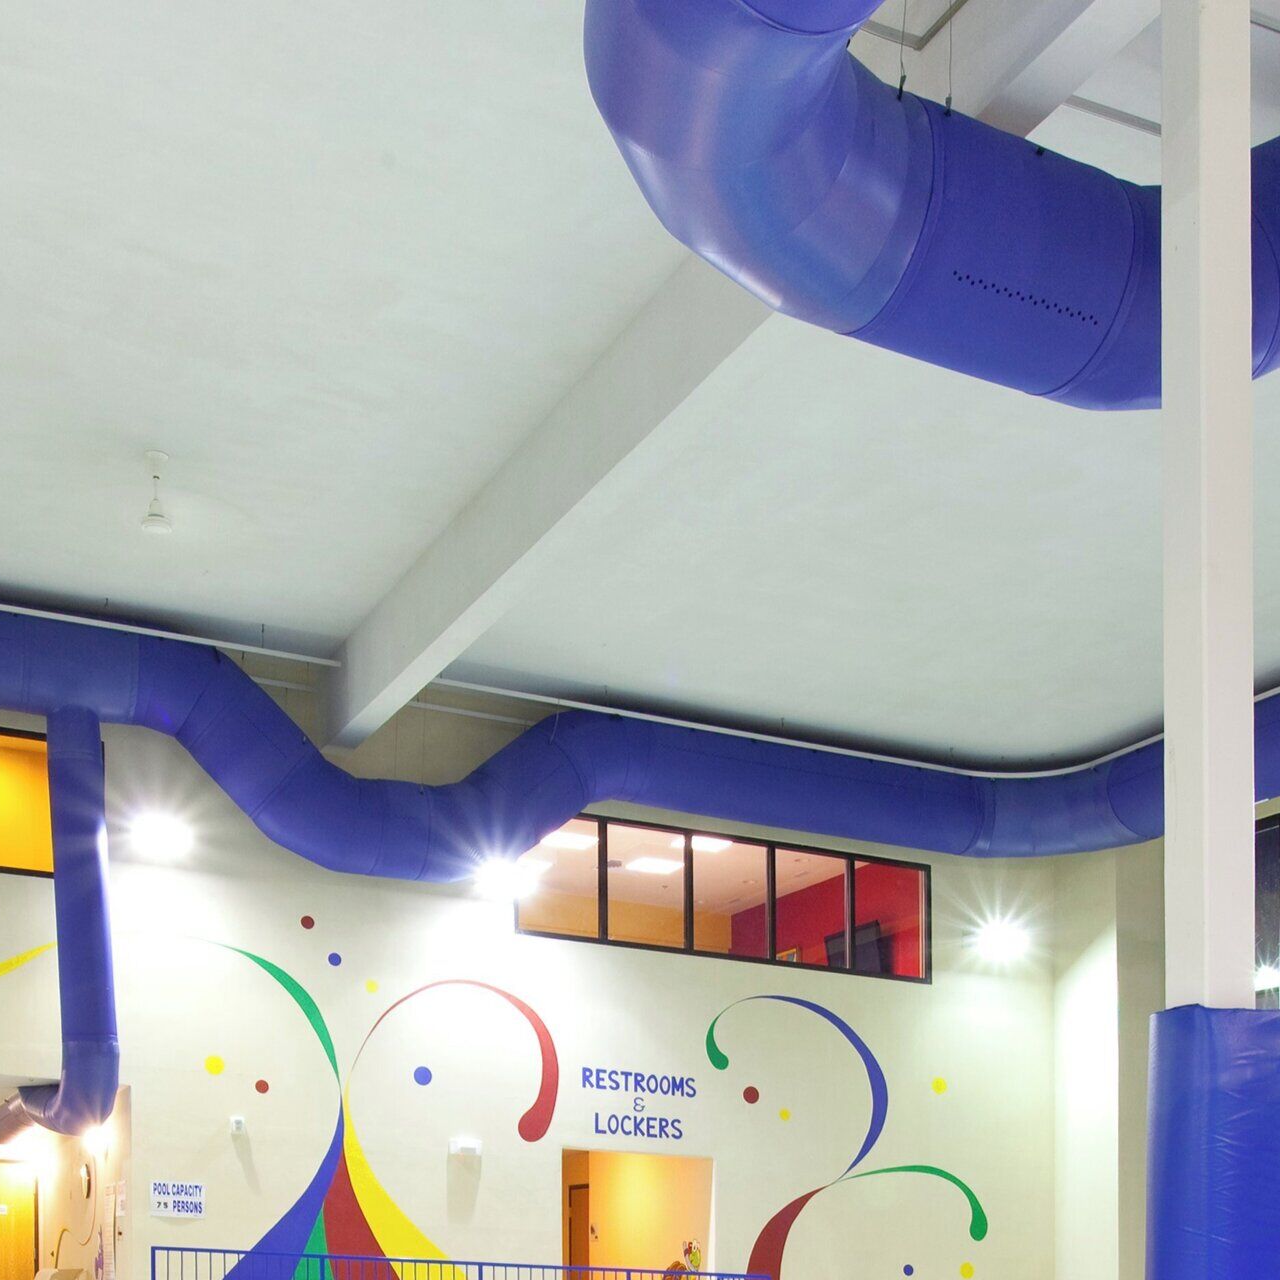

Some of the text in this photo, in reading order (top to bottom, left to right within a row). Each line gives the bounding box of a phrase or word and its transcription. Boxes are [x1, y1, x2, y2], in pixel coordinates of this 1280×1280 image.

[582, 1066, 697, 1098] RESTROOMS
[633, 1097, 645, 1112] &
[594, 1112, 683, 1140] LOCKERS
[153, 1183, 203, 1197] POOL CAPACITY
[173, 1200, 203, 1214] PERSONS
